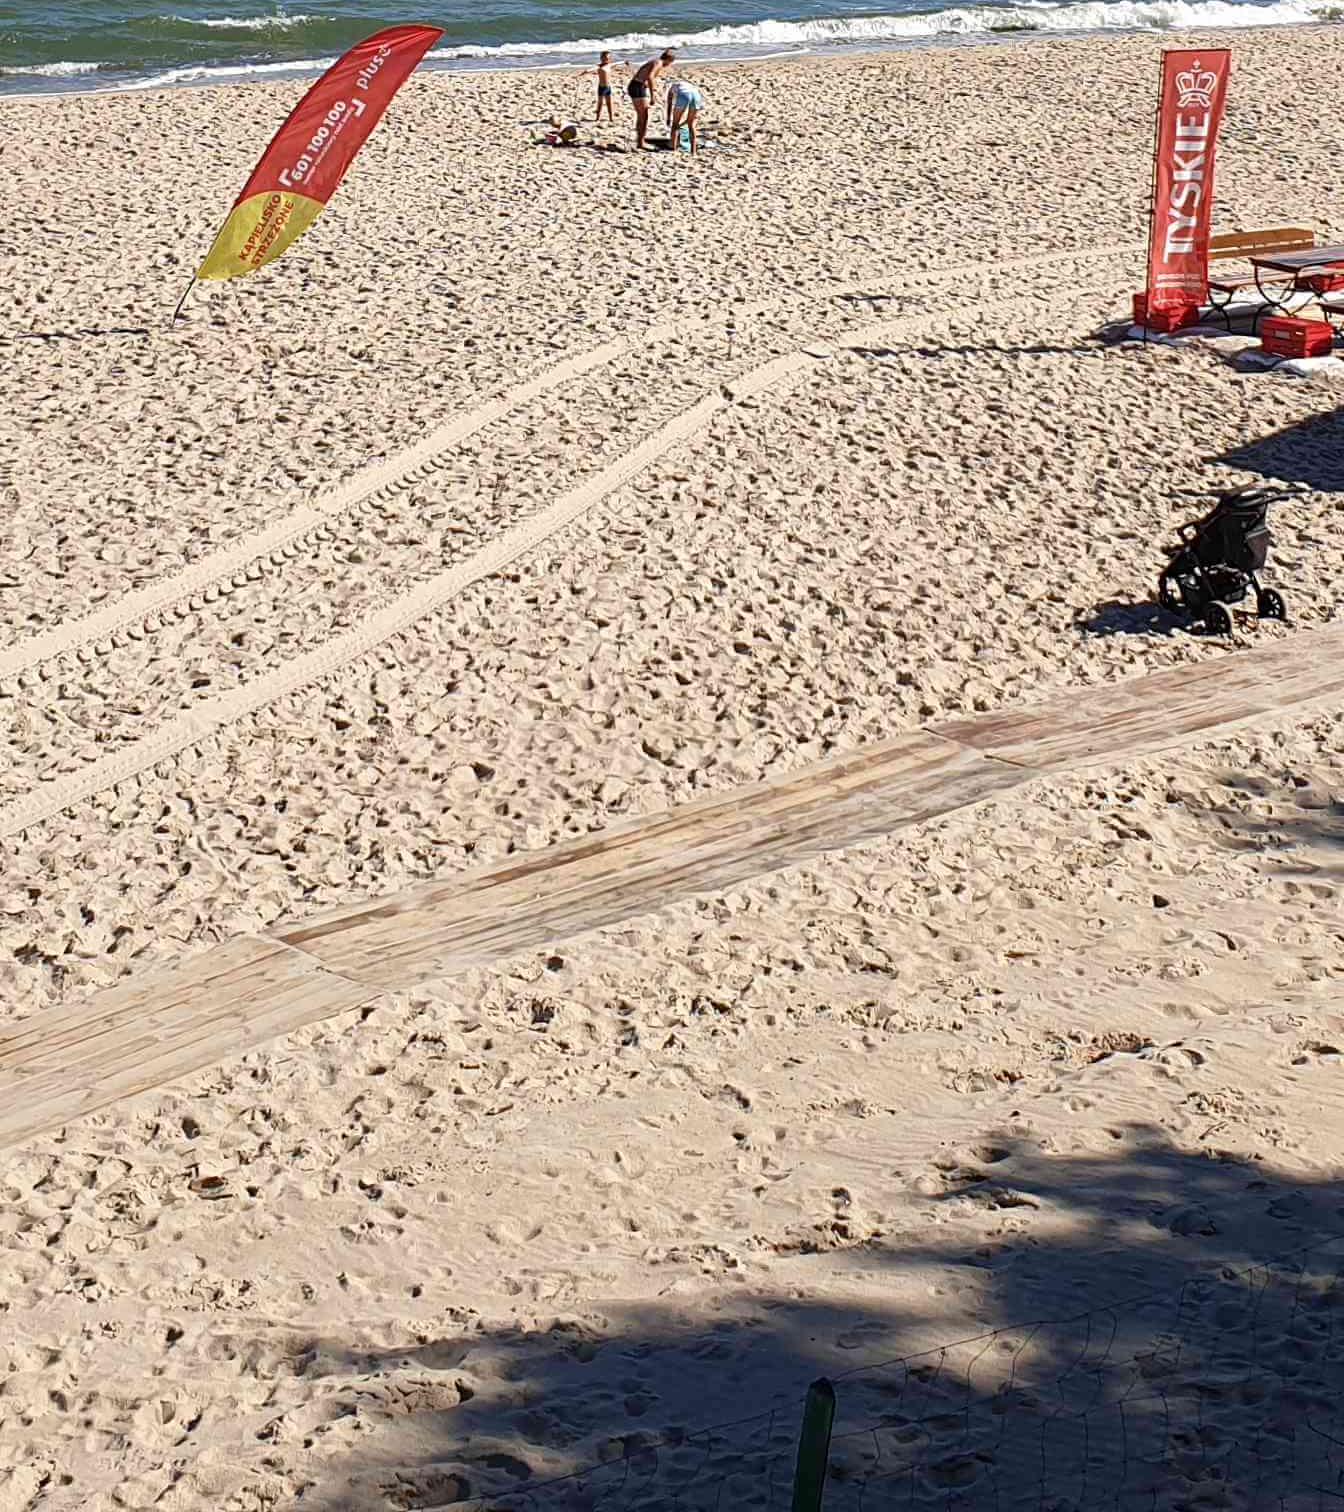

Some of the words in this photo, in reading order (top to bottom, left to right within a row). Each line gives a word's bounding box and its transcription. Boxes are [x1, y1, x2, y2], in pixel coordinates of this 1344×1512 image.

[357, 54, 385, 90] plus
[291, 155, 312, 180] 601
[309, 126, 330, 153] 100
[326, 100, 347, 131] 100
[1164, 113, 1210, 264] TYSKIE
[238, 194, 281, 262] KĄPIELISKO
